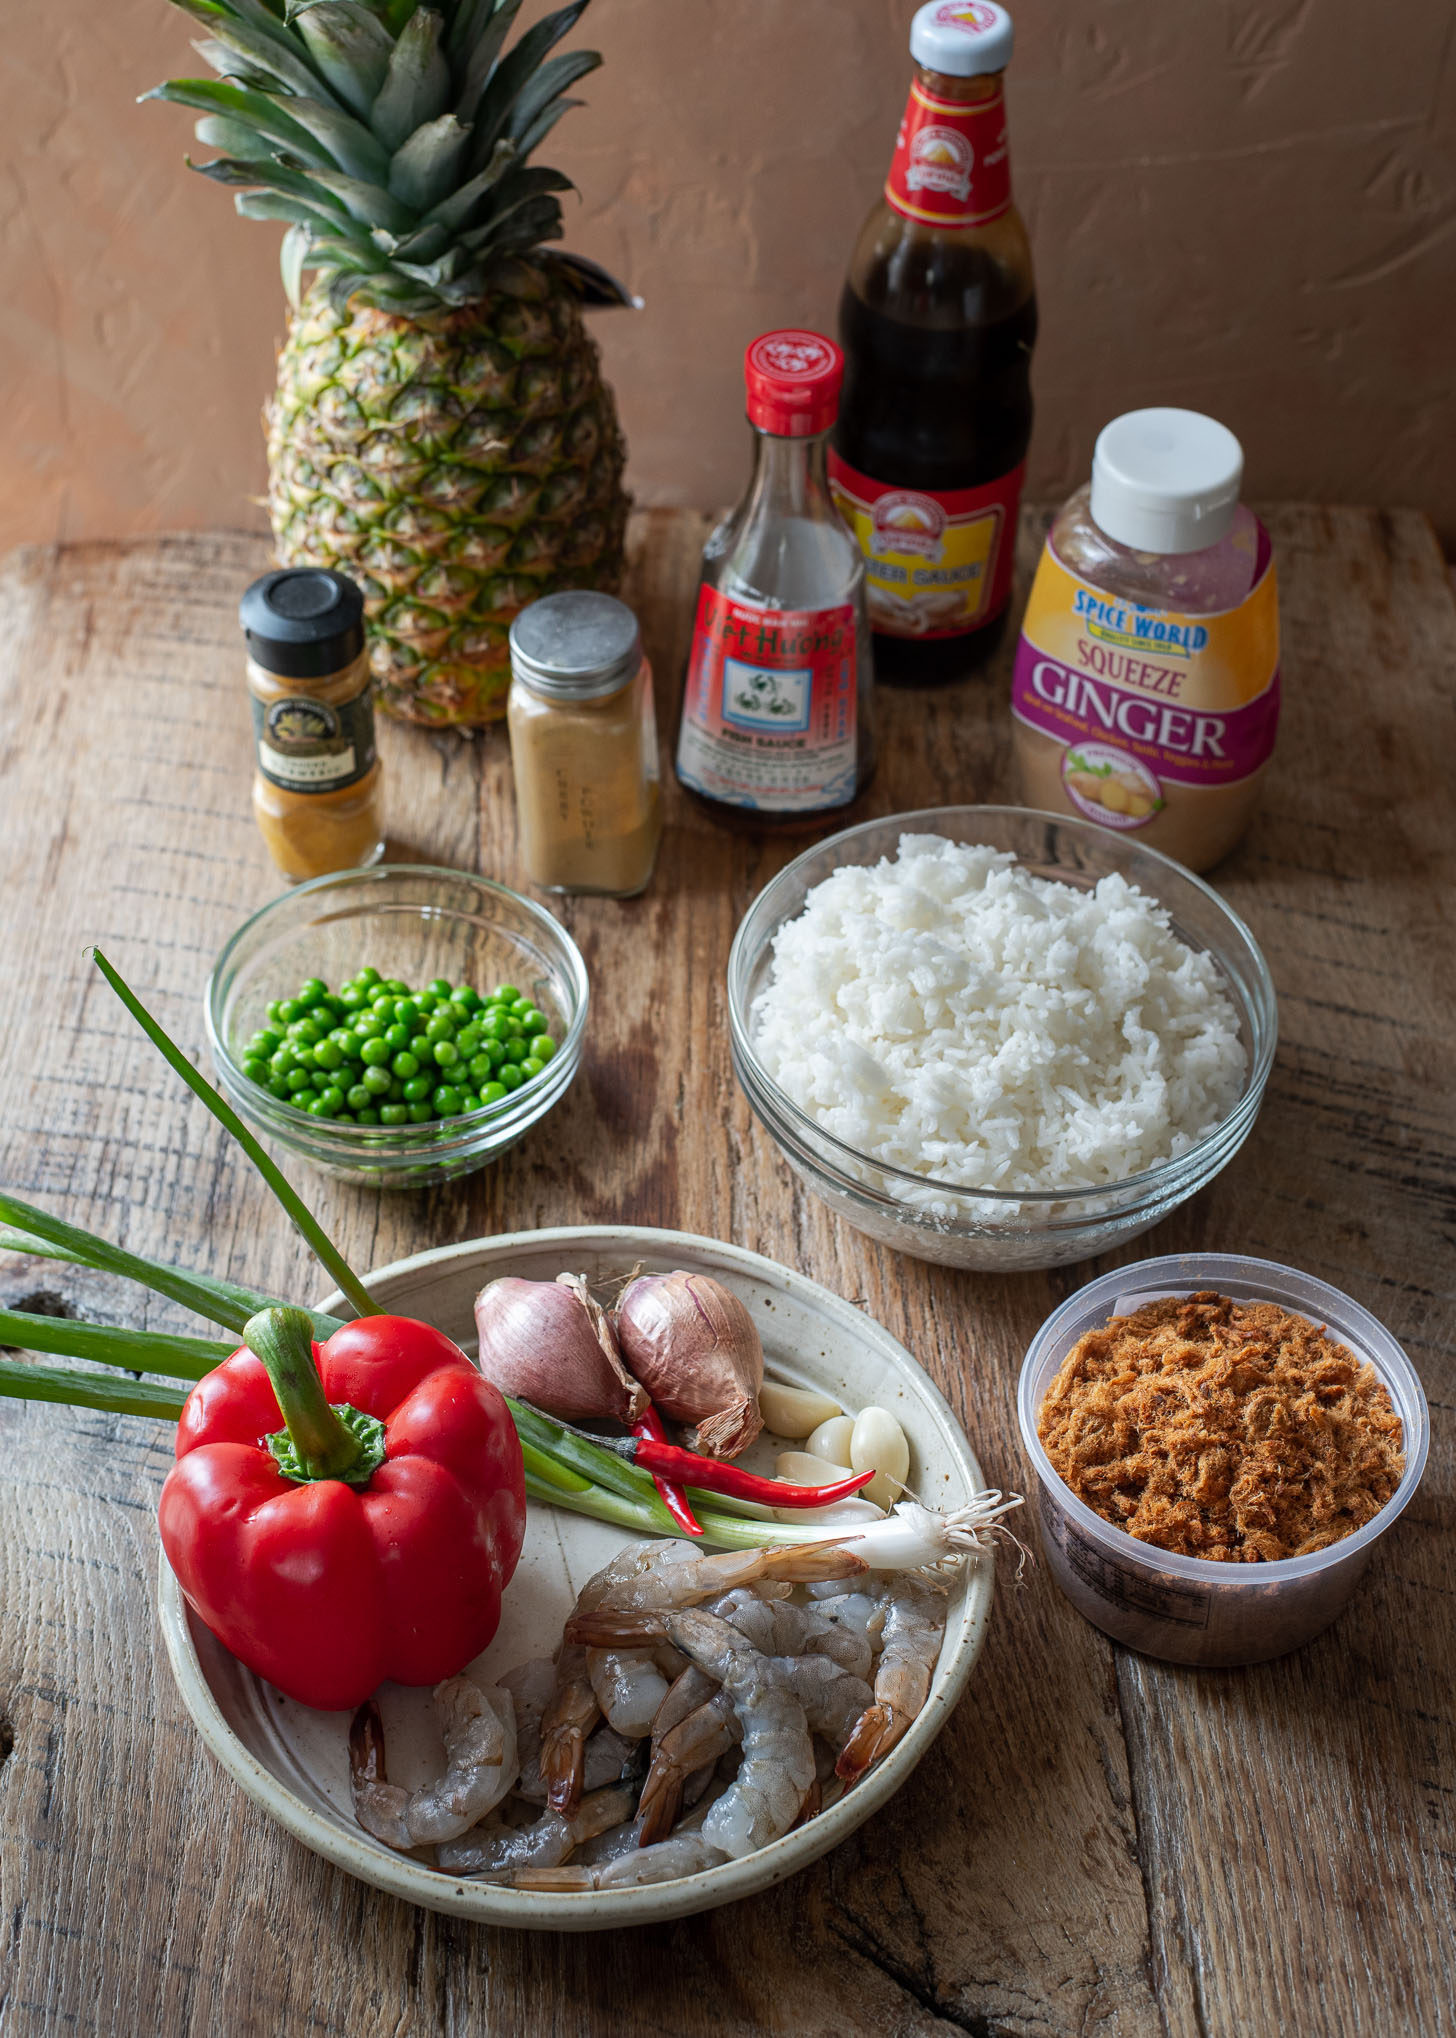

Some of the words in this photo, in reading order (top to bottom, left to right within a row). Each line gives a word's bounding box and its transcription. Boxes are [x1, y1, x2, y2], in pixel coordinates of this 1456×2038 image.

[912, 561, 981, 586] SAUCE
[1074, 589, 1126, 630] SPICE
[1135, 615, 1208, 651] WORLD
[1077, 638, 1187, 698] SQUEEZE
[721, 727, 752, 744] FISH
[756, 736, 806, 749] SAUCE
[1032, 661, 1226, 757] GINGER
